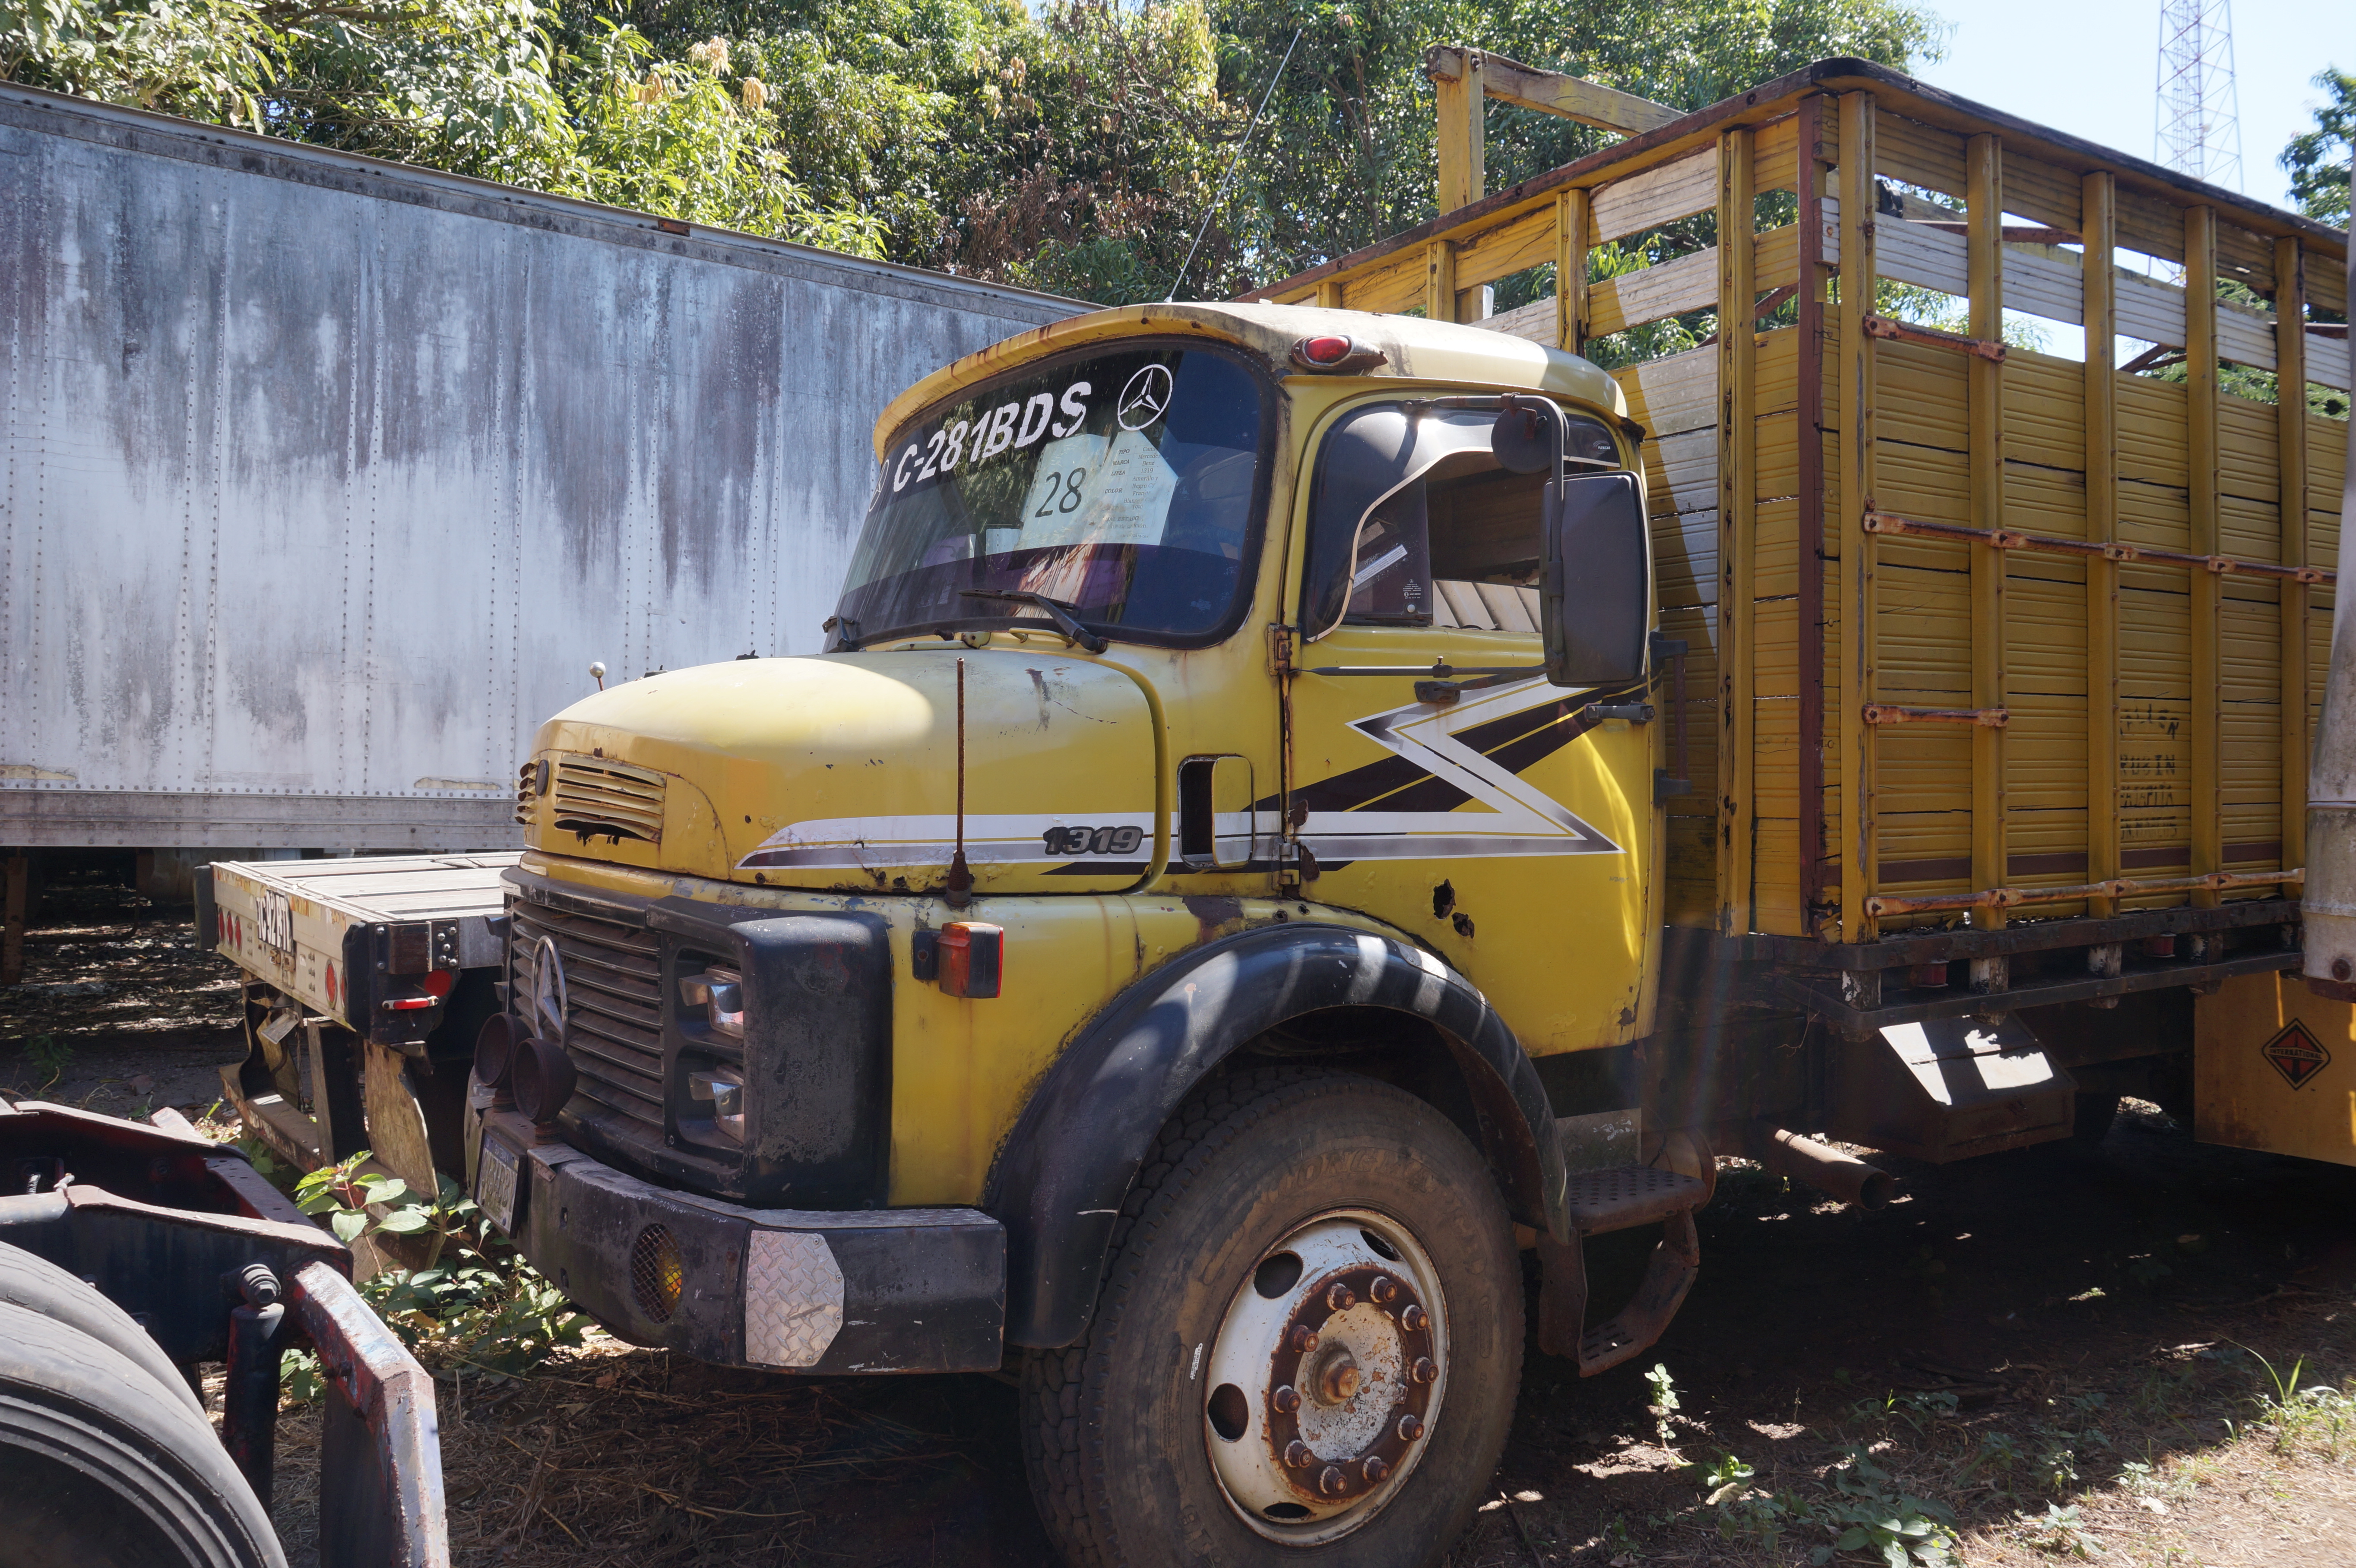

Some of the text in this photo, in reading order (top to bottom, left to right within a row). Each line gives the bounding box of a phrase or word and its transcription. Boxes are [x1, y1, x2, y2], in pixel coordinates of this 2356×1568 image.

[893, 382, 1092, 493] C-281BDS
[1035, 467, 1087, 518] 28
[1043, 826, 1144, 855] 1319
[2269, 1047, 2322, 1059] INTERNATIONAL
